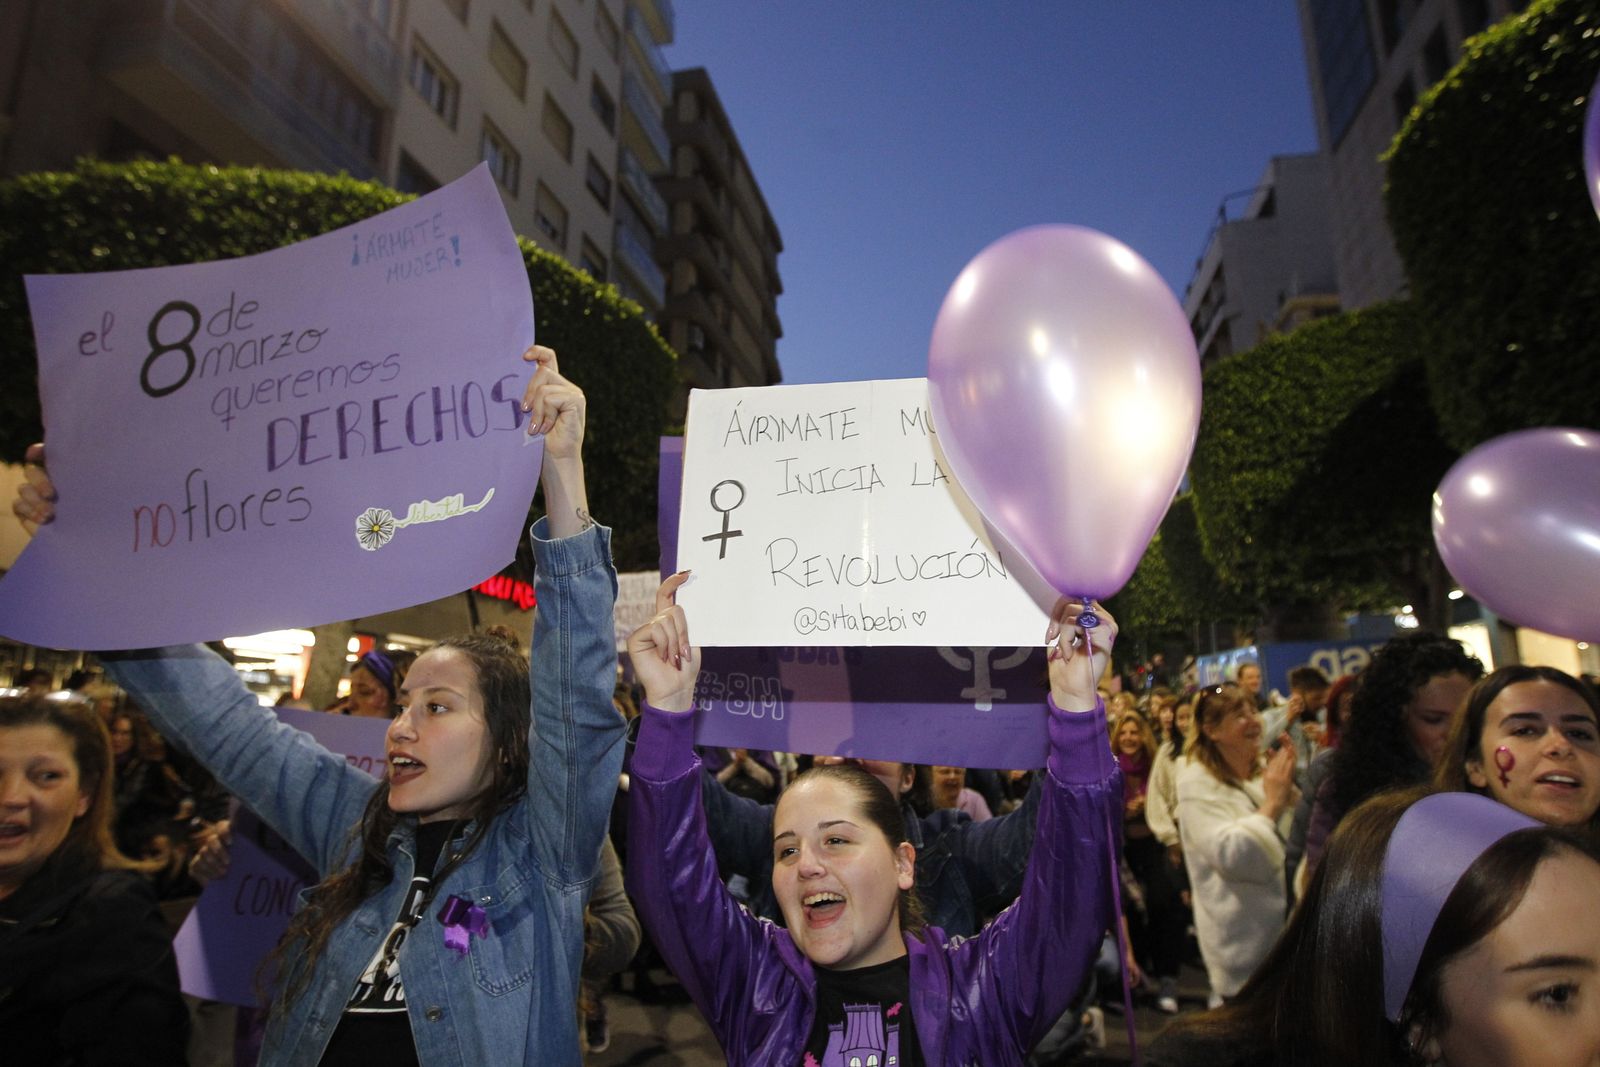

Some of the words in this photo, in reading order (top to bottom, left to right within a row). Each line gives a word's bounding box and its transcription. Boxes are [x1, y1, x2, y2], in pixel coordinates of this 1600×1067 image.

[78, 311, 115, 356] el
[140, 300, 201, 398] 8
[207, 291, 259, 337] de
[199, 328, 328, 379] marzo
[211, 353, 400, 431] queremos
[266, 374, 524, 472] DERECHOS
[900, 406, 936, 436] MU
[133, 503, 176, 552] no
[182, 468, 312, 541] flores
[911, 459, 950, 488] LA
